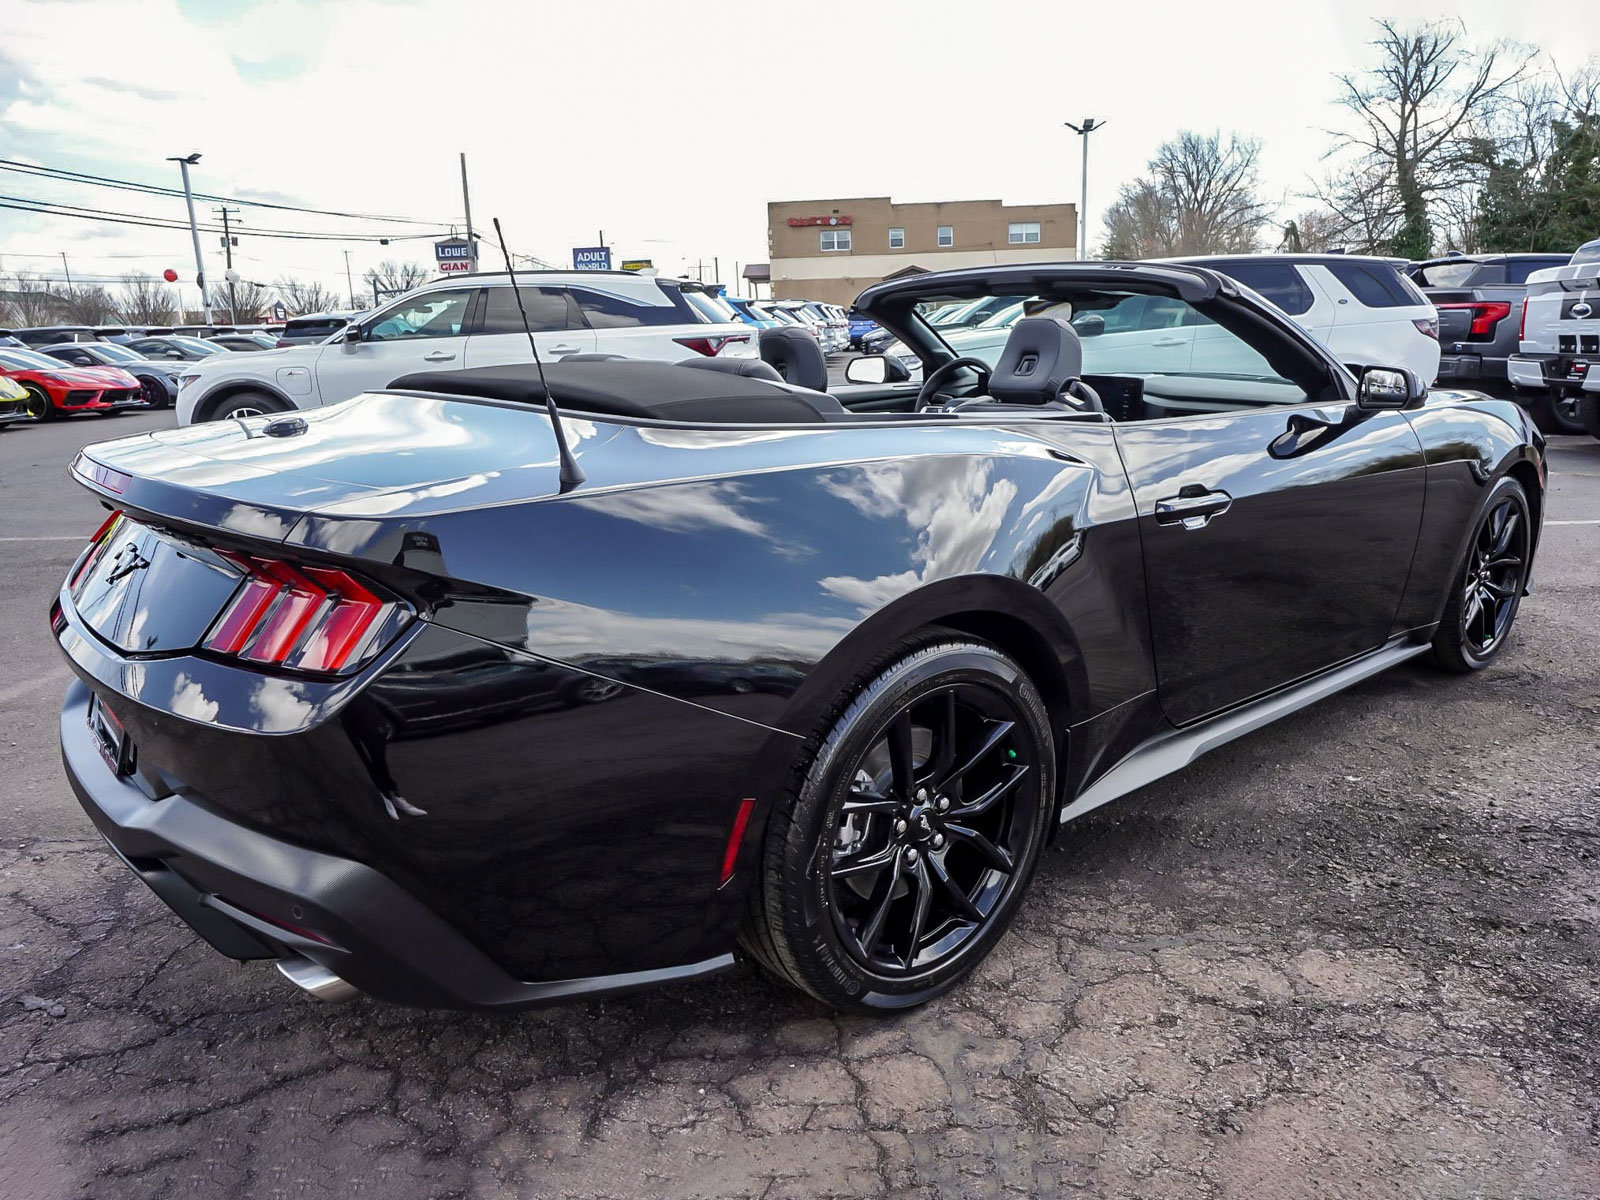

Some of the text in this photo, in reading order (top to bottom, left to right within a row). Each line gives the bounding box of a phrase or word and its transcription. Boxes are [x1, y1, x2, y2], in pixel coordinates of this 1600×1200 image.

[438, 247, 468, 257] LOWE
[577, 252, 606, 262] ADULT
[440, 262, 470, 271] GIAN
